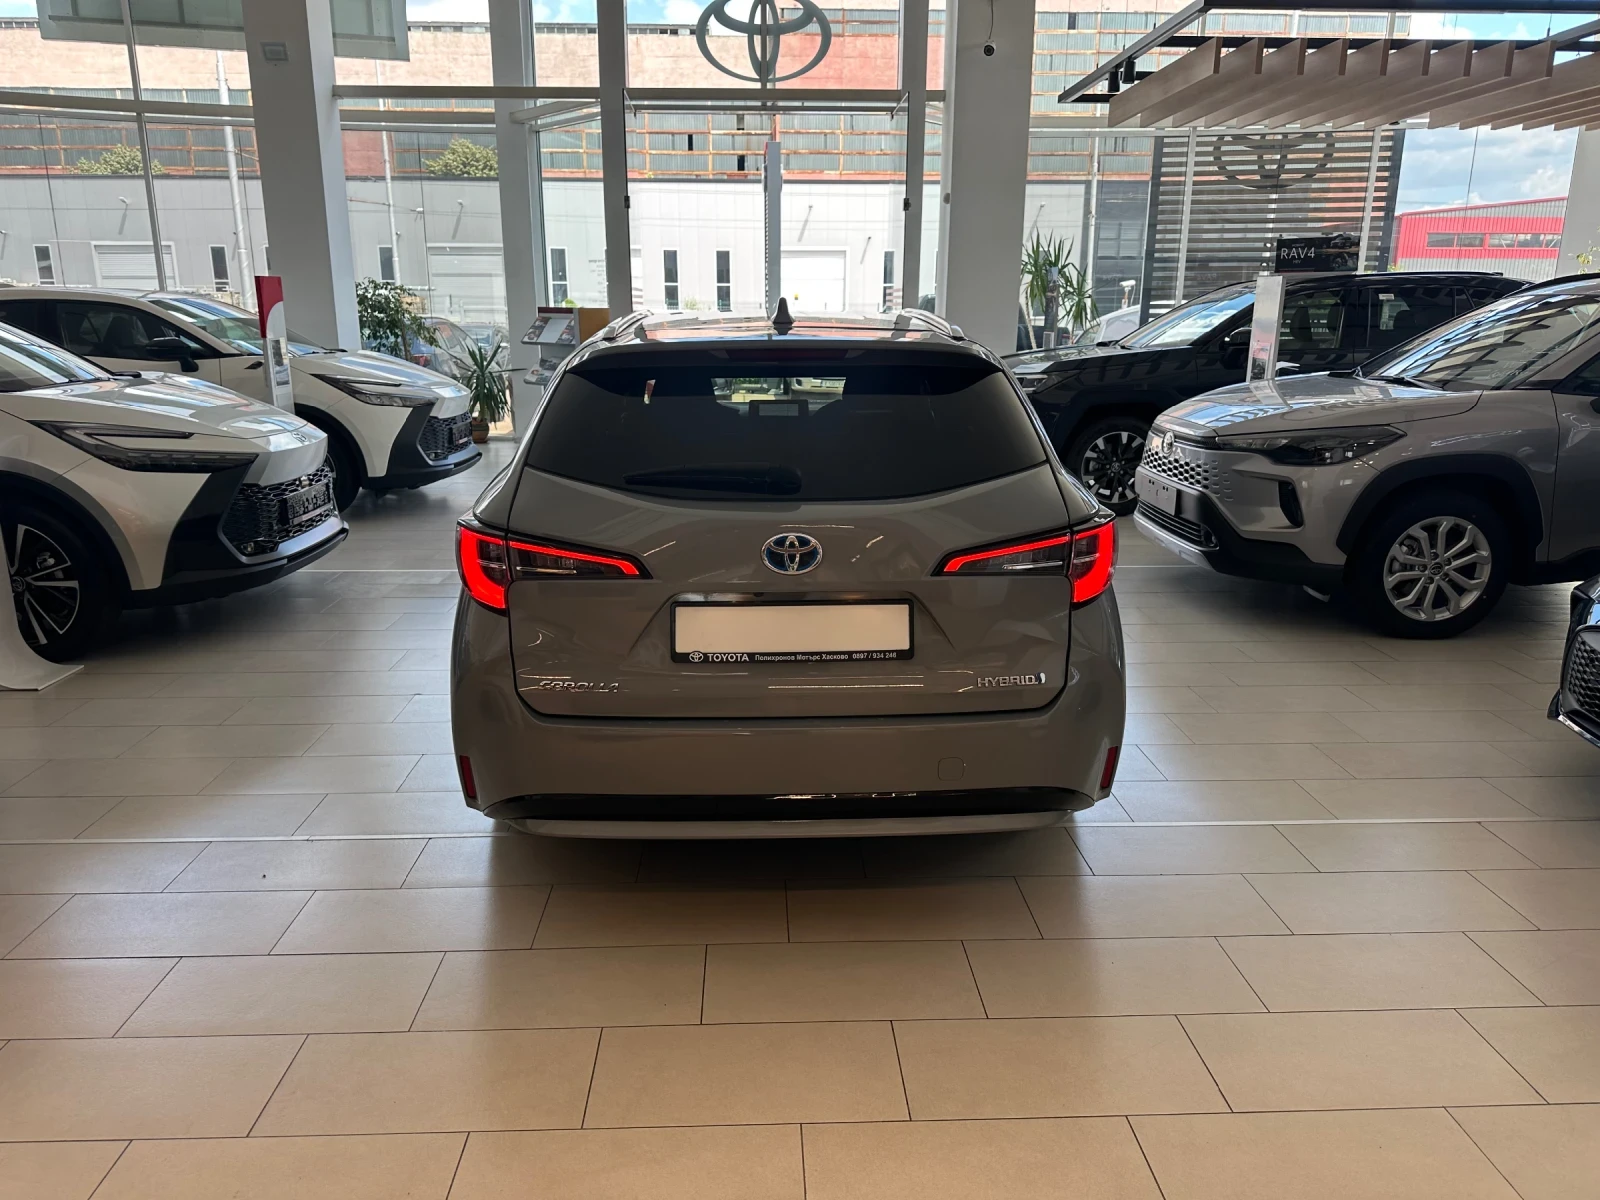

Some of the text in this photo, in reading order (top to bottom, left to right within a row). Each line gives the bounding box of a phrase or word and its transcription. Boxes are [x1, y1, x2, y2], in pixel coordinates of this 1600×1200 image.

[1280, 247, 1315, 259] RAV4
[707, 653, 749, 662] TOYOTA
[540, 680, 619, 693] COROLLA
[977, 675, 1037, 688] HYBRID
